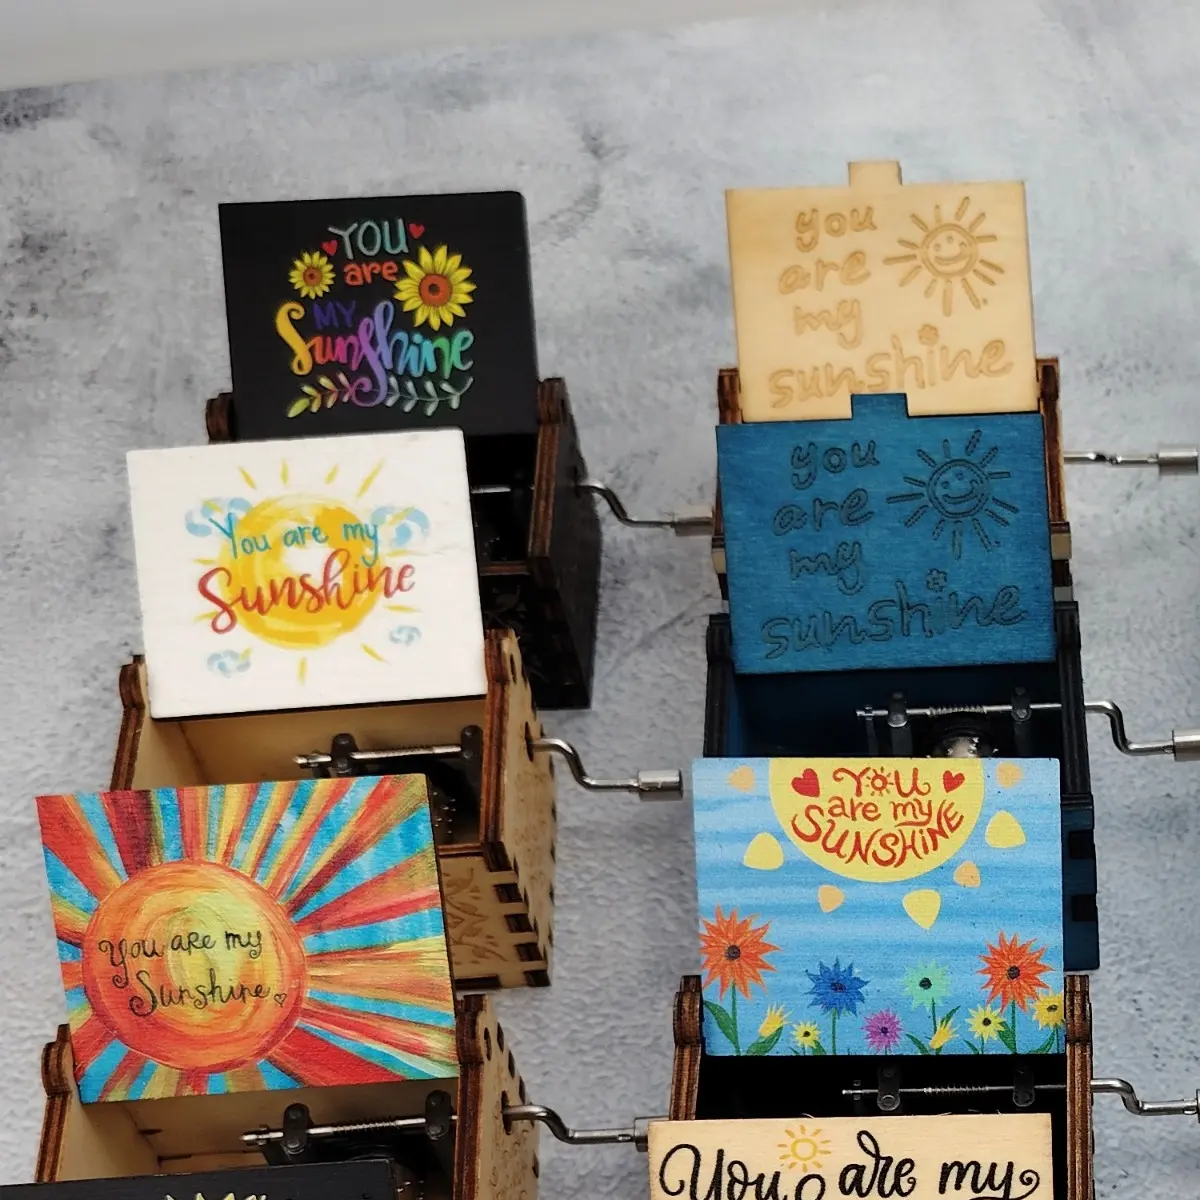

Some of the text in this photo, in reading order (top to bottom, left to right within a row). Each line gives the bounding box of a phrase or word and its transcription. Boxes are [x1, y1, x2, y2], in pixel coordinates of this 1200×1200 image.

[327, 218, 408, 259] YOU
[795, 206, 877, 252] you
[344, 261, 398, 286] are
[778, 250, 871, 295] are
[313, 302, 356, 329] MY
[793, 299, 863, 350] my
[275, 300, 474, 407] Sunshine
[768, 324, 1013, 409] sunshine
[790, 440, 880, 490] you
[773, 488, 874, 536] are
[208, 512, 379, 566] You are my
[198, 548, 416, 634] Sunshine
[789, 541, 863, 596] my
[762, 568, 1028, 660] sunshine
[828, 796, 932, 827] are my
[99, 938, 164, 988] You
[225, 930, 262, 959] my
[129, 968, 270, 1017] Sunshine
[839, 1130, 916, 1198] are
